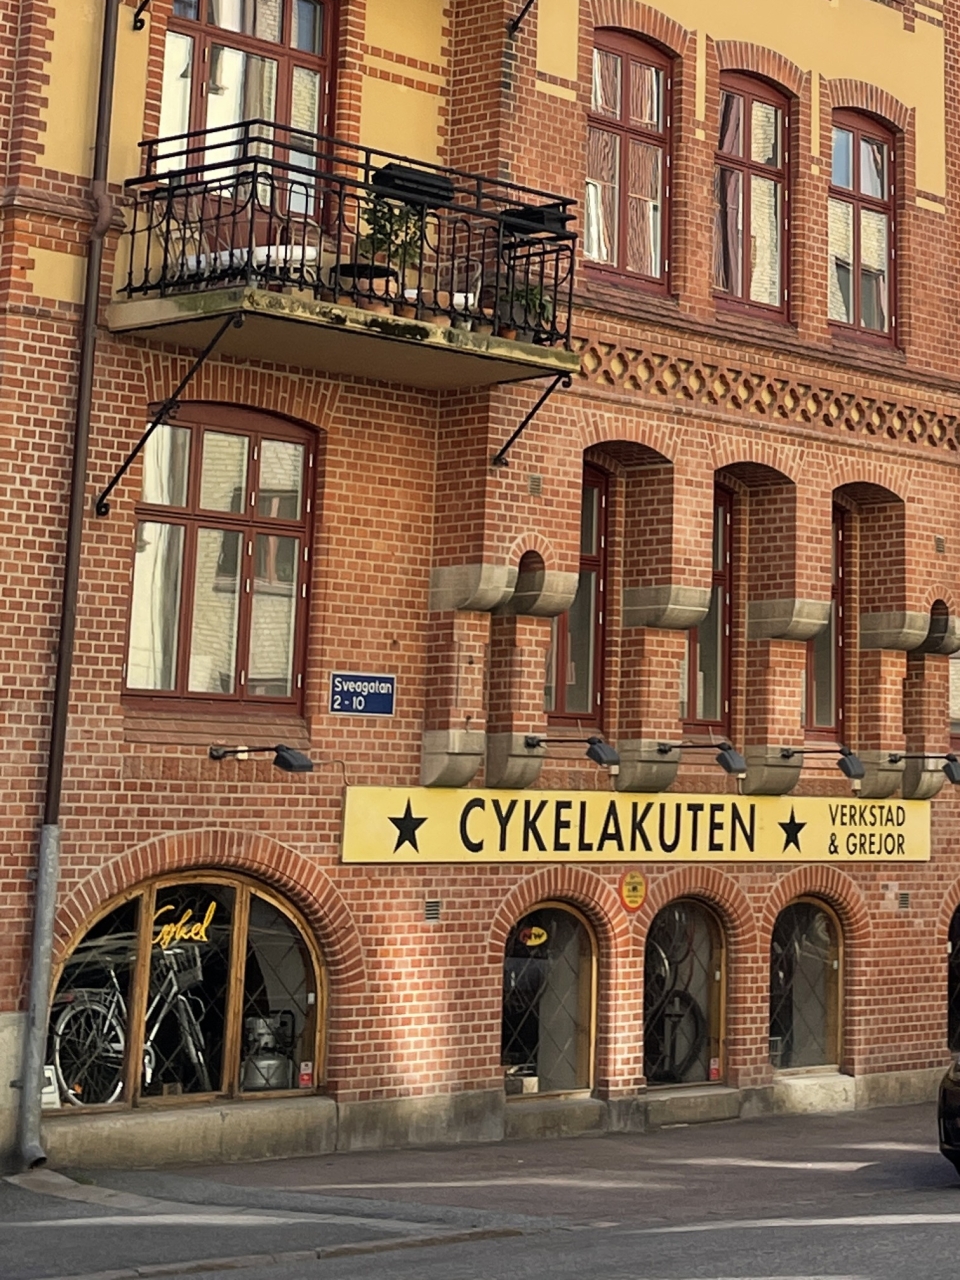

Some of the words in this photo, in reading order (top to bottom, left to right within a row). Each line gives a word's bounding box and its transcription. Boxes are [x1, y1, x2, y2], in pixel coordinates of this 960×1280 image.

[334, 677, 392, 696] Sveagatan
[333, 695, 342, 709] 2
[352, 696, 365, 710] 10
[459, 797, 756, 853] CYKELAKUTEN
[828, 803, 906, 827] VERKSTAD
[828, 832, 840, 855] &
[846, 832, 906, 856] GREJOR
